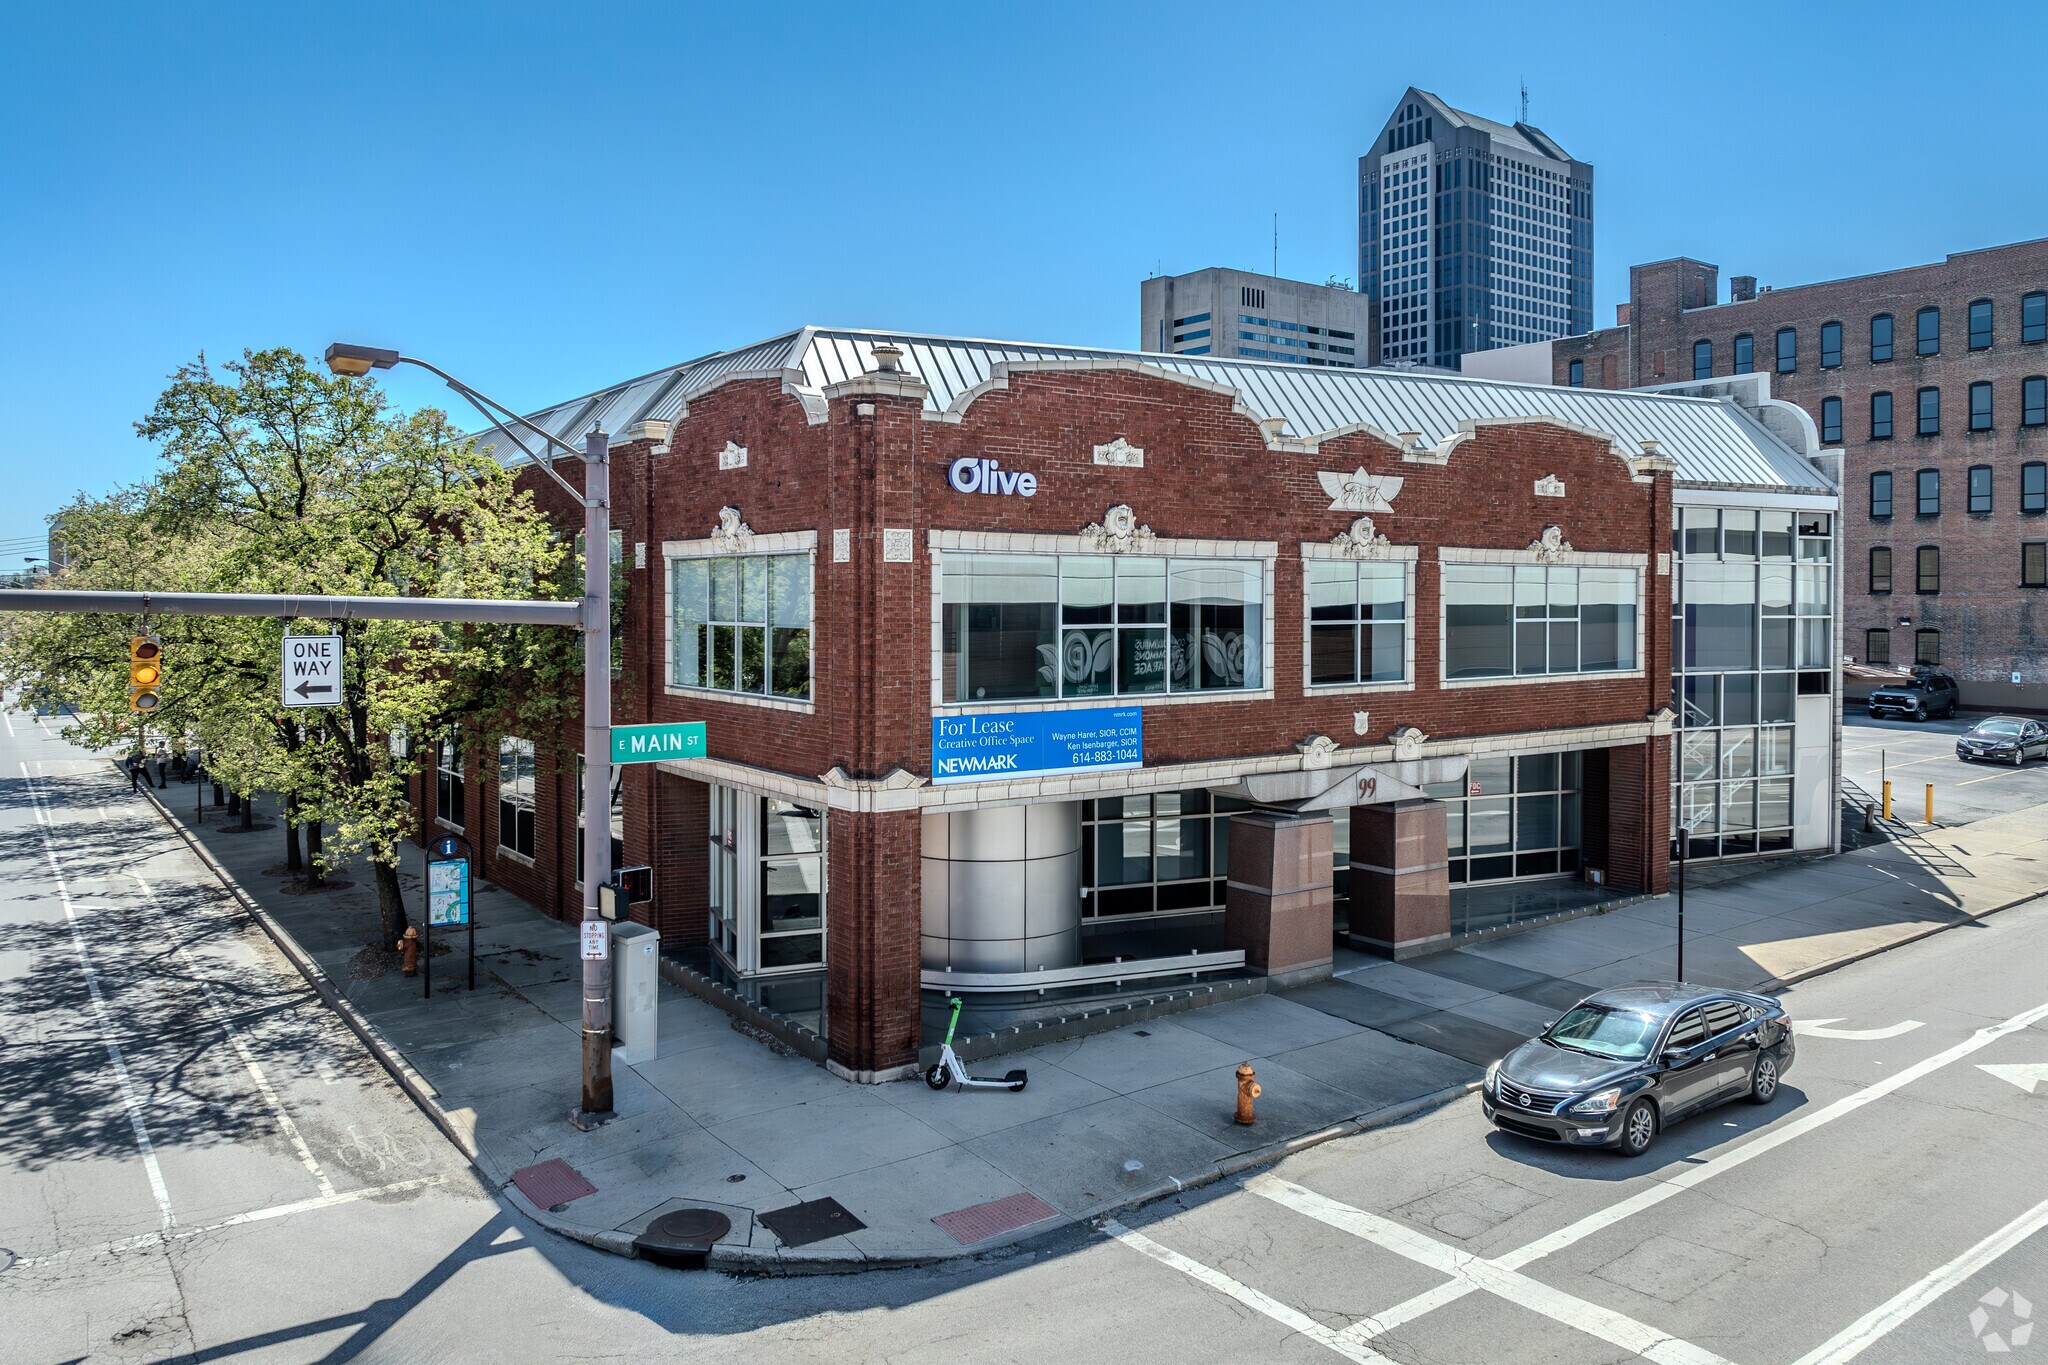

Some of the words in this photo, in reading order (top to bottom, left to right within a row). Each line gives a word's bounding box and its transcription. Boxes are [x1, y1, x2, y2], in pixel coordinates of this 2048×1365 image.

[948, 458, 1037, 497] Olive
[294, 643, 331, 658] ONE
[293, 661, 332, 676] WAY
[939, 719, 966, 737] For
[971, 717, 1015, 734] Lease
[1051, 732, 1076, 742] Wayne
[1077, 730, 1098, 739] Harer,
[1099, 728, 1118, 738] SIOR,
[1119, 727, 1137, 736] CCIM
[619, 740, 626, 750] E
[631, 733, 682, 754] MAIN
[687, 735, 699, 746] ST
[938, 738, 978, 750] Creative
[979, 735, 1008, 747] Office
[1009, 734, 1035, 748] Space
[1067, 742, 1081, 750] Ken
[1082, 739, 1120, 750] Isenbarger,
[1120, 738, 1138, 747] SIOR
[938, 753, 1019, 774] NEWMARK
[1072, 748, 1138, 764] 614-883-1044
[1359, 777, 1376, 799] 99
[589, 923, 598, 932] NO
